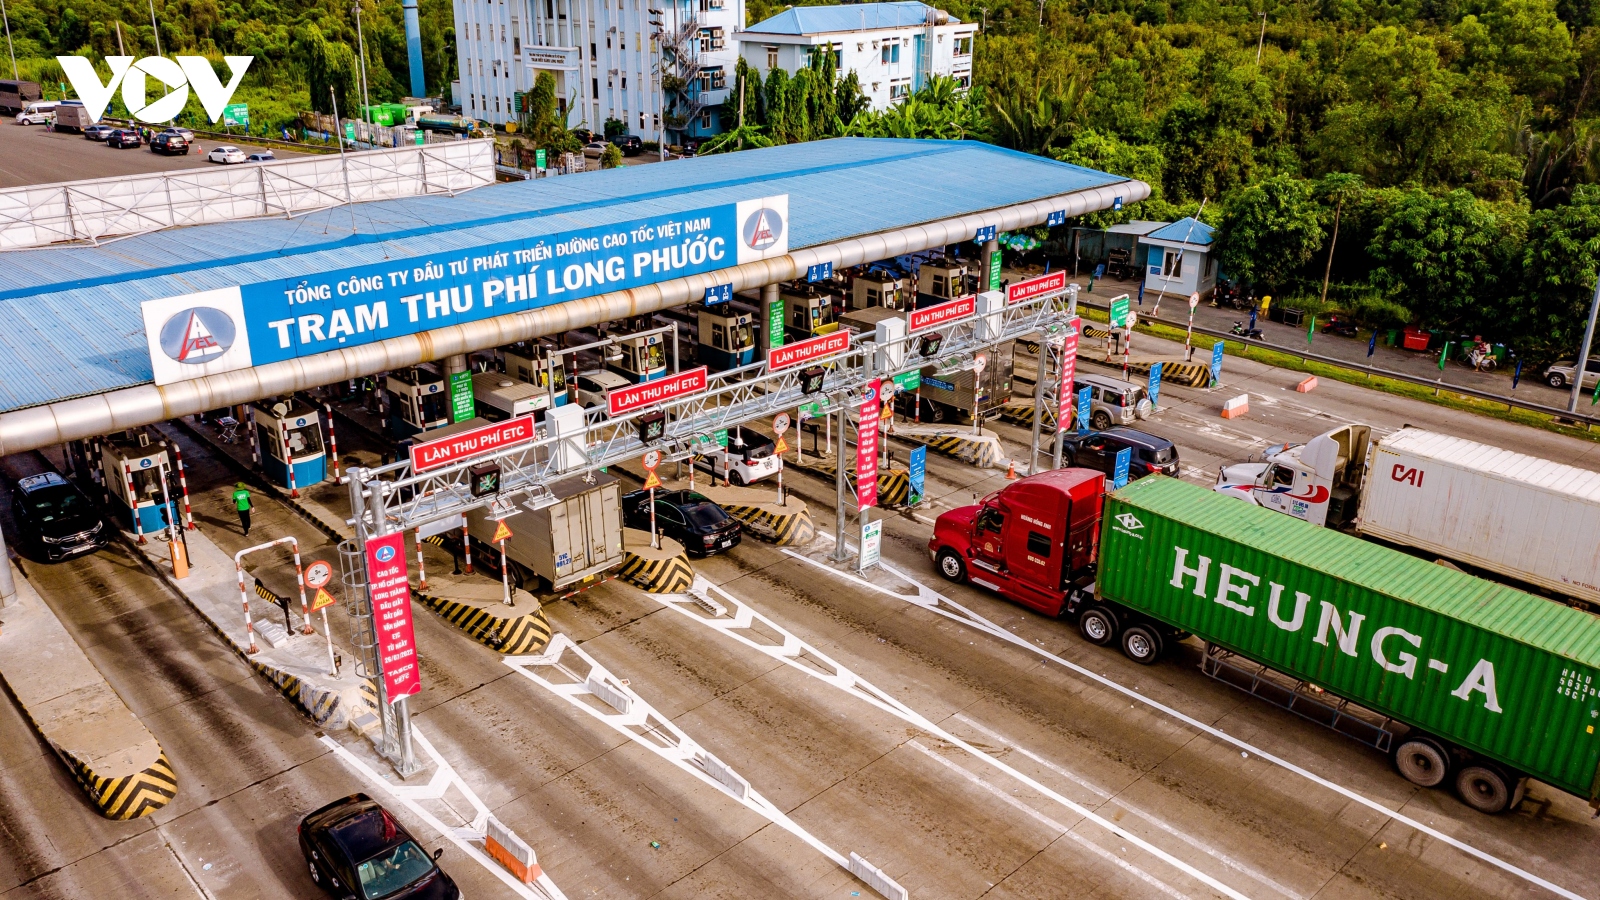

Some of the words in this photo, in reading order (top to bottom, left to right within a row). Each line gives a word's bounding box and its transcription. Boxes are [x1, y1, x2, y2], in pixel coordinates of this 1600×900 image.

[284, 280, 332, 306] TỔNG
[337, 276, 383, 296] CÔNG
[388, 270, 408, 287] TY
[414, 260, 443, 281] ĐẦU
[450, 256, 468, 276] TƯ
[473, 247, 509, 272] PHÁT
[513, 241, 552, 264] TRIỂN
[556, 234, 599, 256] ĐƯỜNG
[603, 233, 627, 248] CAO
[630, 226, 655, 244] TỐC
[657, 220, 682, 239] VIỆT
[685, 218, 711, 233] NAM
[268, 300, 389, 349] TRẠM
[400, 285, 473, 323] THU
[483, 265, 540, 307] PHÍ
[547, 256, 625, 294] LONG
[633, 236, 725, 277] PHƯỚC
[1013, 287, 1025, 297] LÀN
[1027, 284, 1038, 293] THU
[1039, 279, 1049, 290] PHÍ
[1050, 278, 1060, 287] ETC
[916, 314, 929, 325] LÀN
[931, 310, 944, 320] THU
[946, 305, 957, 316] PHÍ
[958, 303, 970, 313] ETC
[776, 351, 793, 364] LÀN
[795, 346, 812, 358] THU
[813, 340, 827, 353] PHÍ
[828, 338, 842, 349] ETC
[618, 393, 639, 407] LÀN
[641, 387, 661, 400] THU
[664, 379, 680, 394] PHÍ
[682, 377, 699, 389] ETC
[424, 446, 450, 462] LÀN
[452, 439, 477, 454] THU
[480, 429, 501, 446] PHÍ
[503, 426, 525, 440] ETC
[1392, 464, 1424, 488] CAI
[389, 566, 399, 575] TỐC
[374, 592, 389, 600] LONG
[389, 587, 406, 597] THÀNH
[392, 632, 401, 640] ETC
[1169, 545, 1503, 714] HEUNG-A
[388, 663, 414, 677] TASCO
[1562, 668, 1592, 684] HALU
